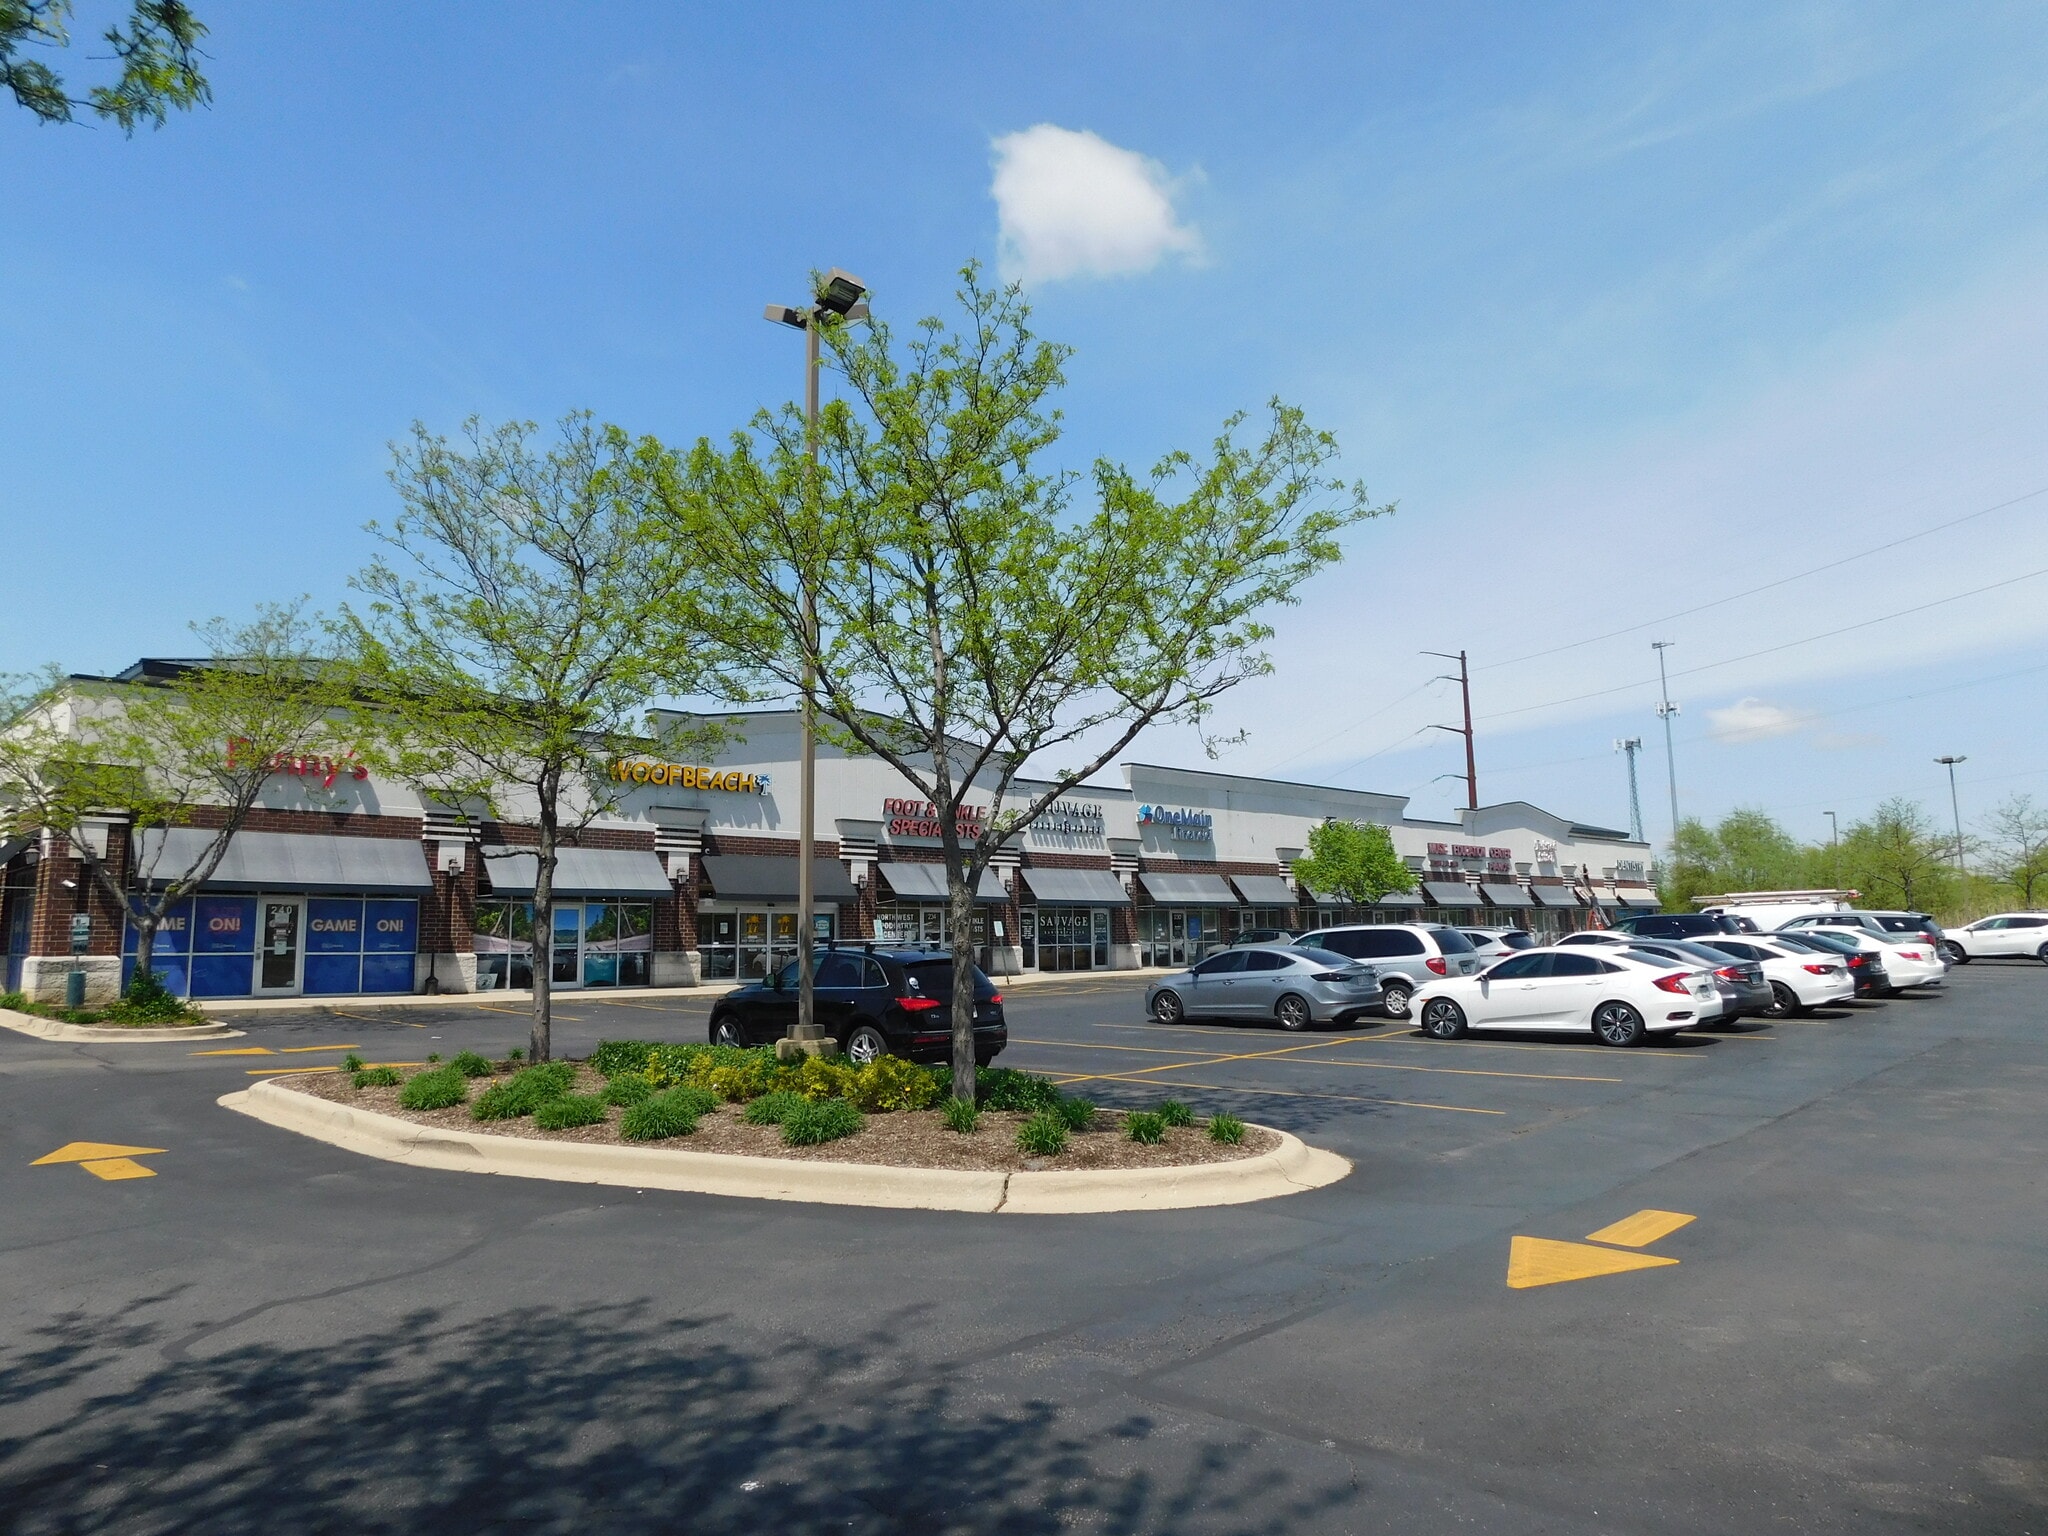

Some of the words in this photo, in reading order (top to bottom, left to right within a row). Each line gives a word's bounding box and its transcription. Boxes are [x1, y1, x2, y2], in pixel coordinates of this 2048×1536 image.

[609, 760, 754, 793] WOOFBEACH
[884, 798, 924, 816] FOOT
[925, 801, 936, 818] &
[1028, 798, 1103, 819] SUVAGE
[1153, 805, 1213, 827] OneMain
[890, 818, 981, 839] SPECIASTS
[1427, 842, 1448, 855] MUSIC
[1452, 844, 1486, 858] EDUCATION
[1489, 847, 1512, 859] CENTER
[1616, 860, 1644, 871] DENTISTRY
[271, 906, 293, 914] 240
[209, 917, 241, 931] ON!
[311, 919, 357, 931] GAME
[377, 919, 404, 931] ON!
